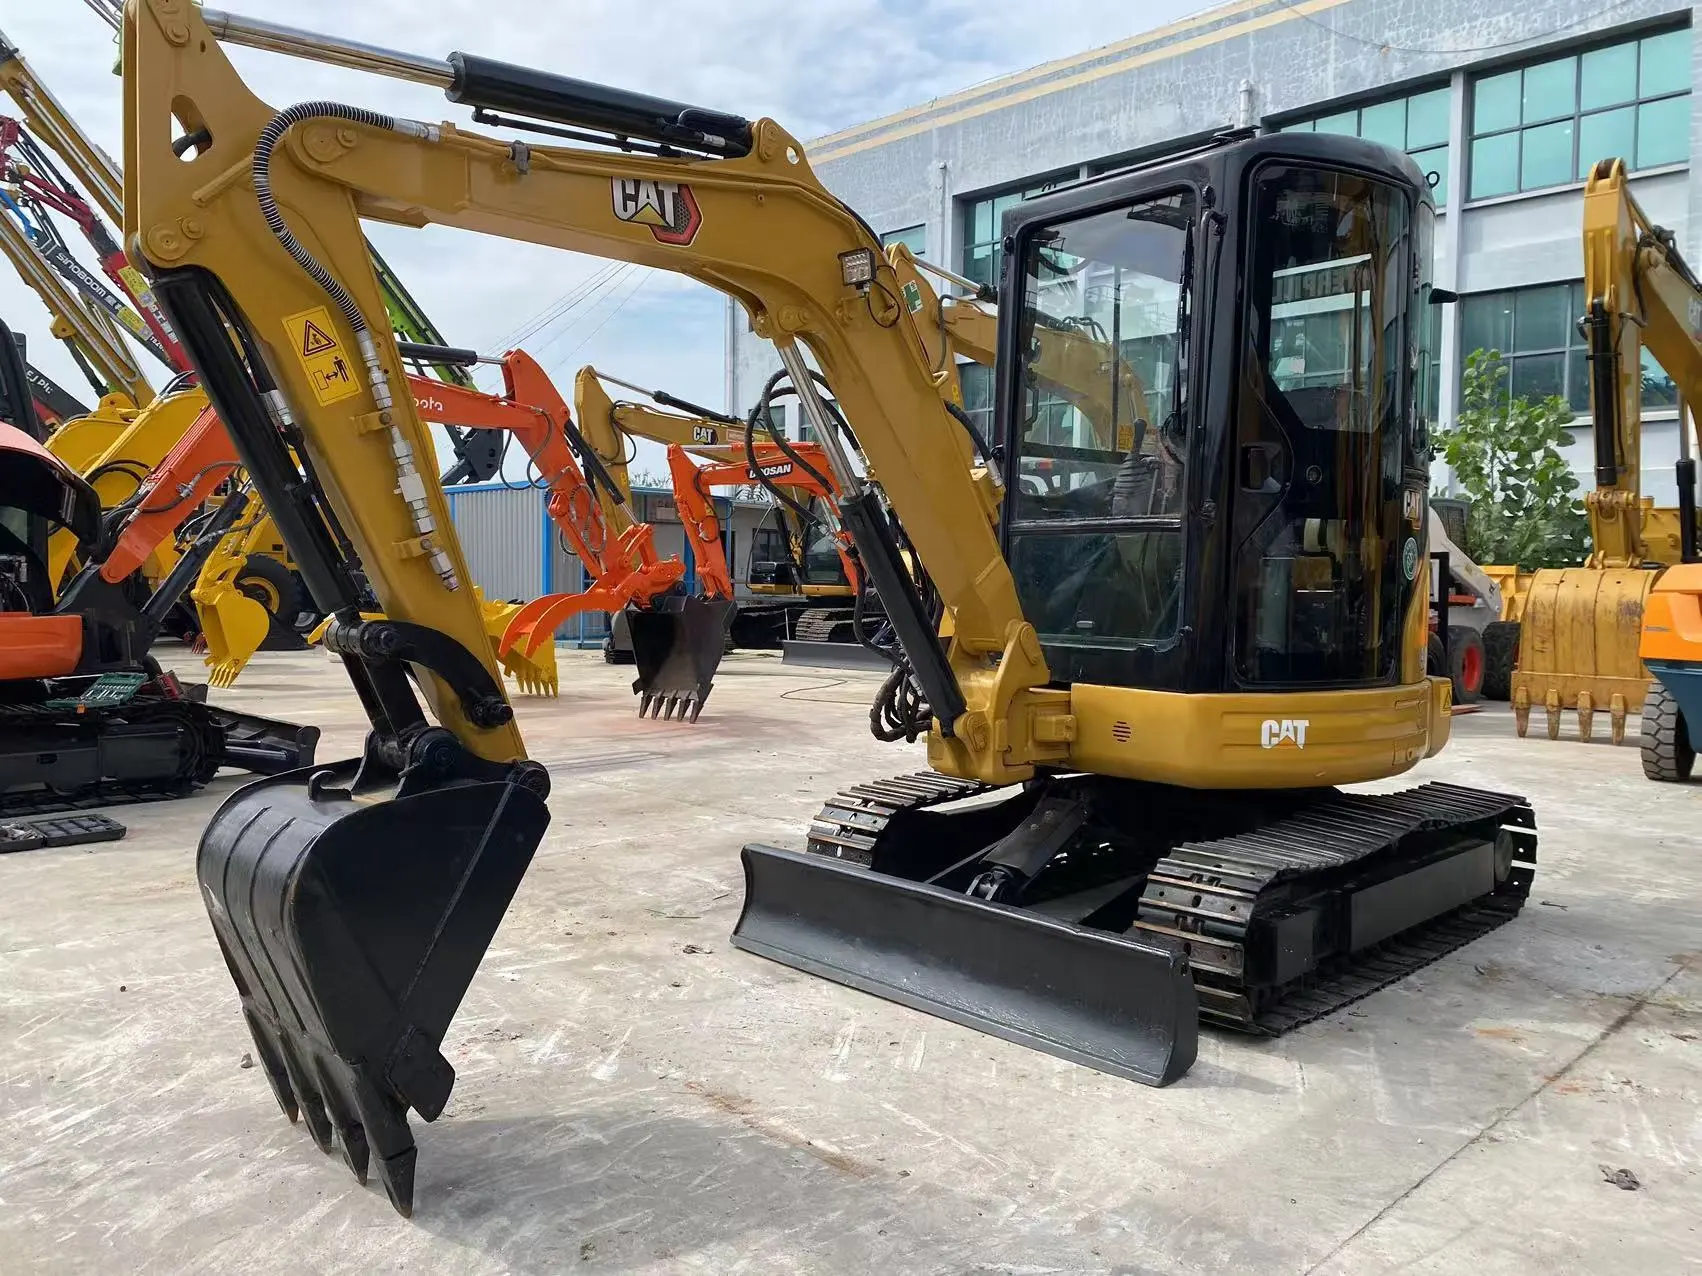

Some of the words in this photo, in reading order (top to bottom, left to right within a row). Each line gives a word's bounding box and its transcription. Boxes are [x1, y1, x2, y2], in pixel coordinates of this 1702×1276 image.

[611, 175, 679, 228] CAT
[693, 426, 713, 443] CAT
[1403, 490, 1420, 519] CAT
[1261, 719, 1310, 749] CAT
